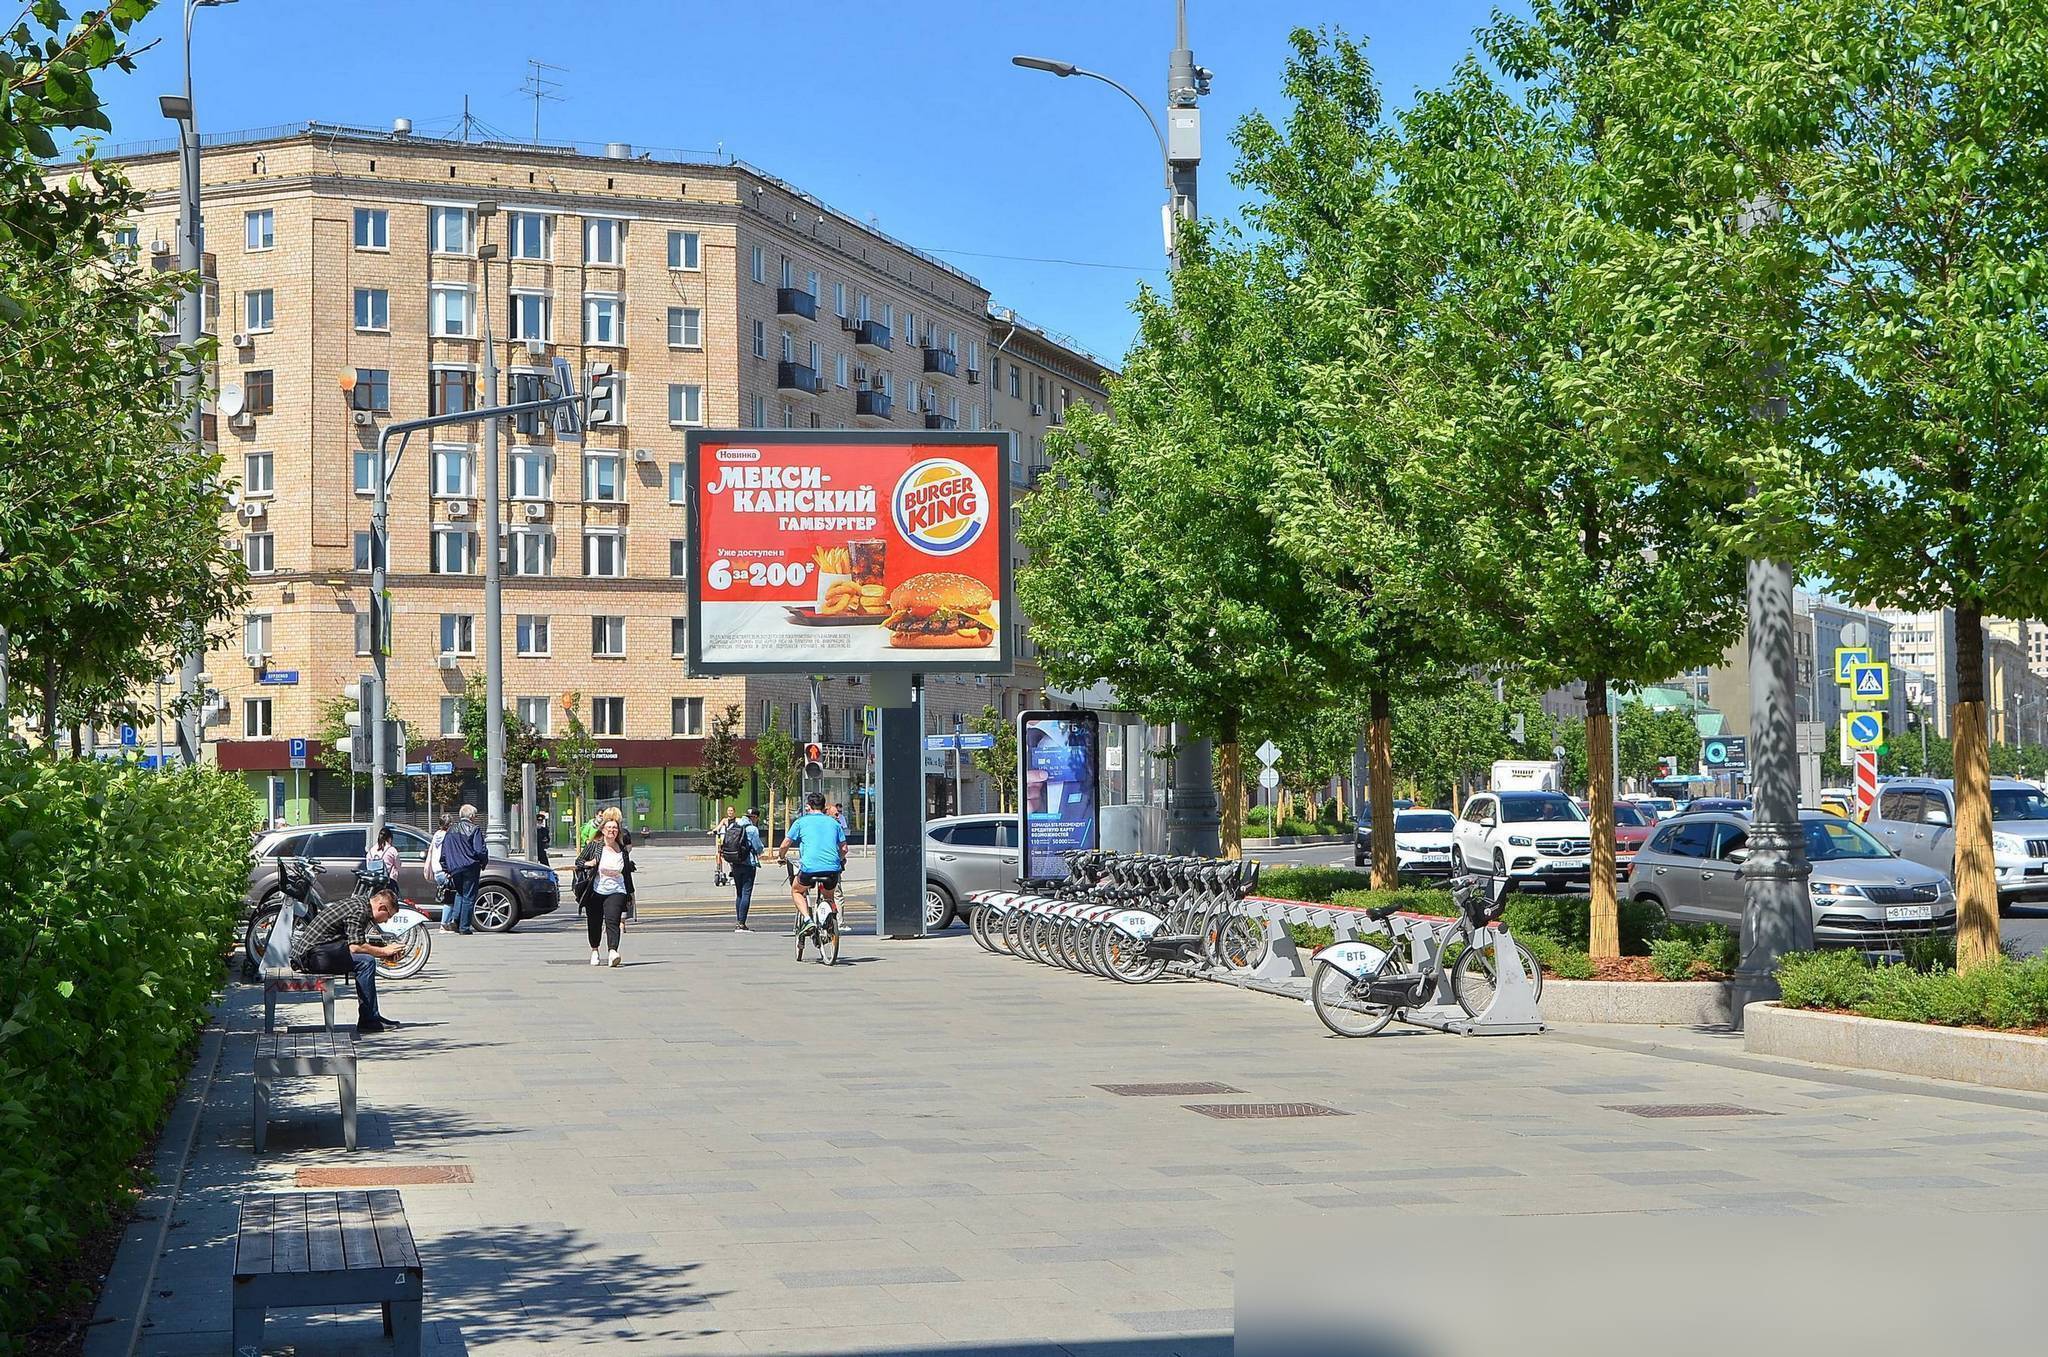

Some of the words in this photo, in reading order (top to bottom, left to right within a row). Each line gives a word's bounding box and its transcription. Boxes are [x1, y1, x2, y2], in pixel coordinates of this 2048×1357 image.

[720, 450, 757, 459] Новинка
[707, 466, 832, 494] МЕКСИ-
[733, 485, 877, 513] КАНСКИЙ
[905, 477, 973, 511] BURGER
[779, 516, 877, 531] ГАМБУРГЕР
[908, 493, 976, 533] KING
[718, 549, 736, 557] Уже
[708, 559, 732, 590] 6
[733, 570, 748, 579] за
[1130, 917, 1146, 925] ВТБ
[1346, 951, 1366, 961] ВТБ
